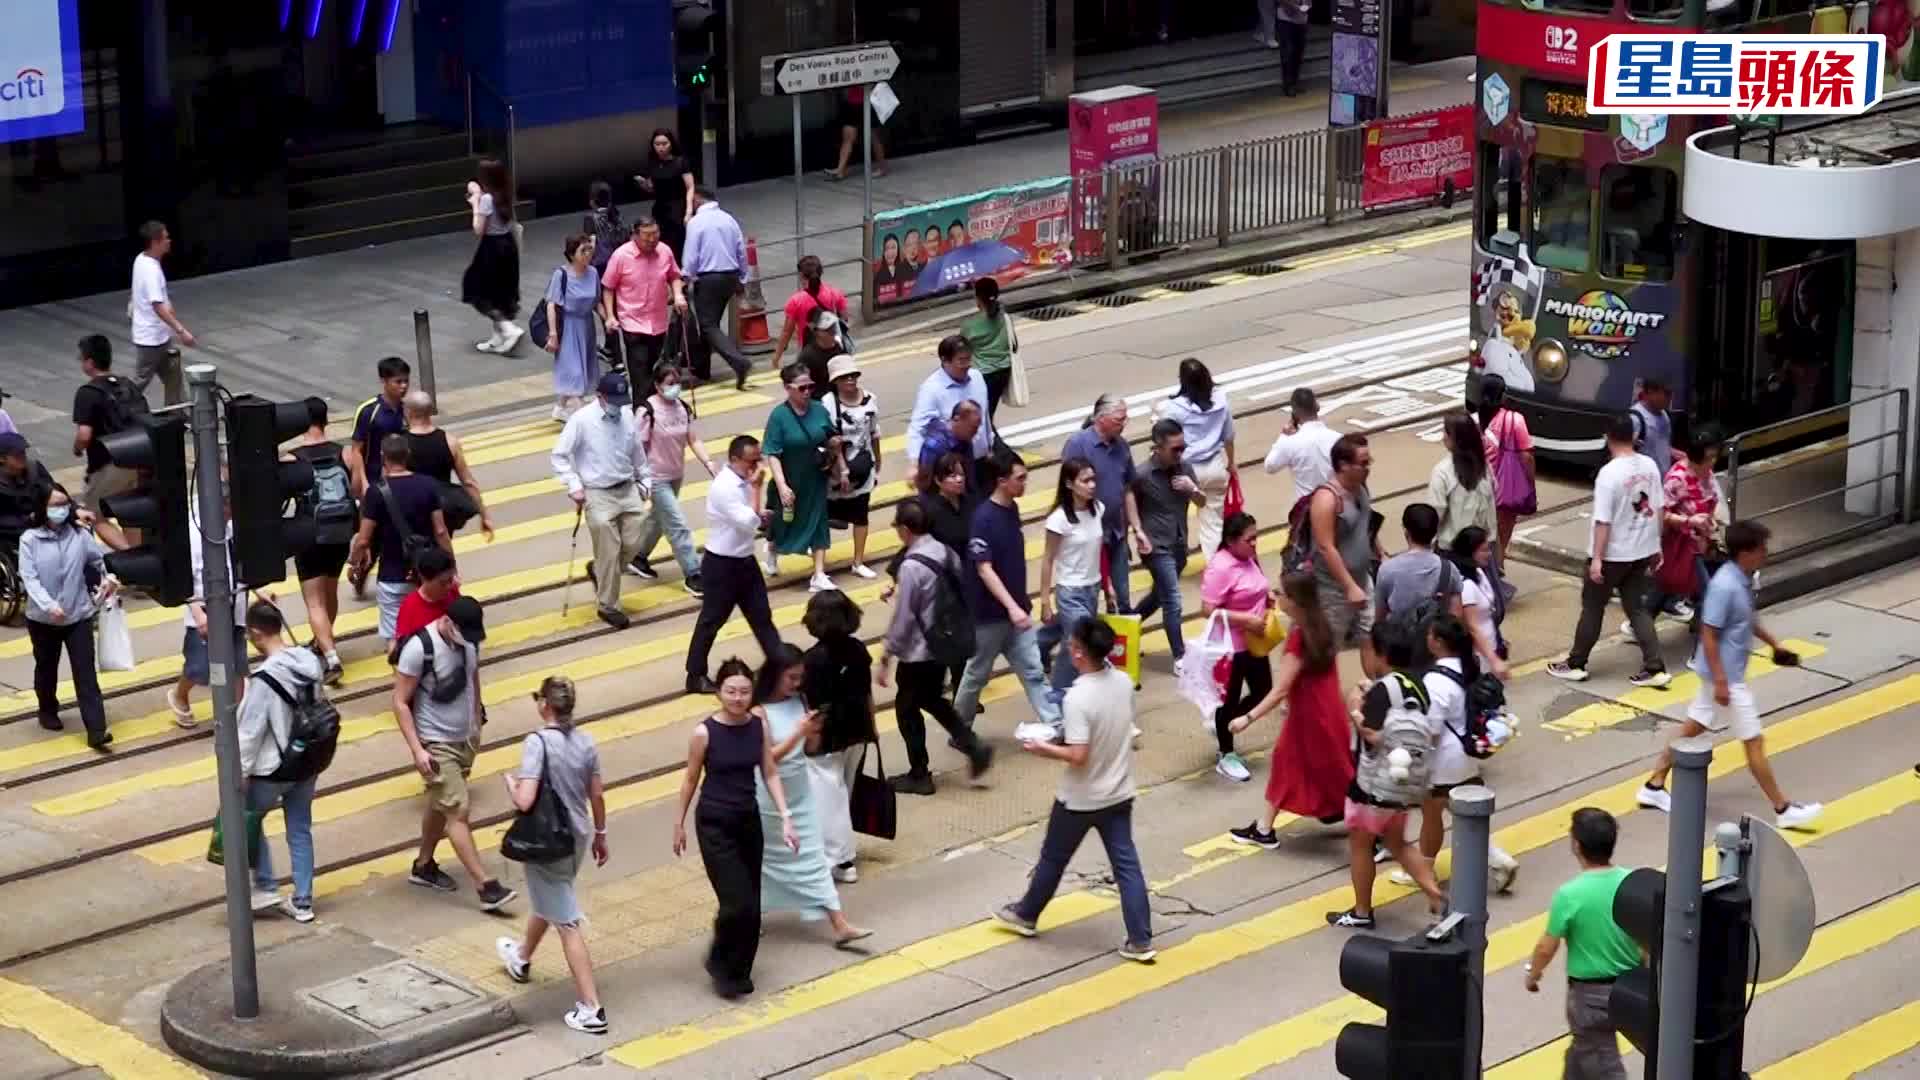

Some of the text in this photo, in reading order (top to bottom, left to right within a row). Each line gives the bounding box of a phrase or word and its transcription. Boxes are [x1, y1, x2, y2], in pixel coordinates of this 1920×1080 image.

[789, 51, 888, 72] Des Voeux Road Central
[0, 74, 44, 102] citi
[1568, 318, 1637, 337] WORLD
